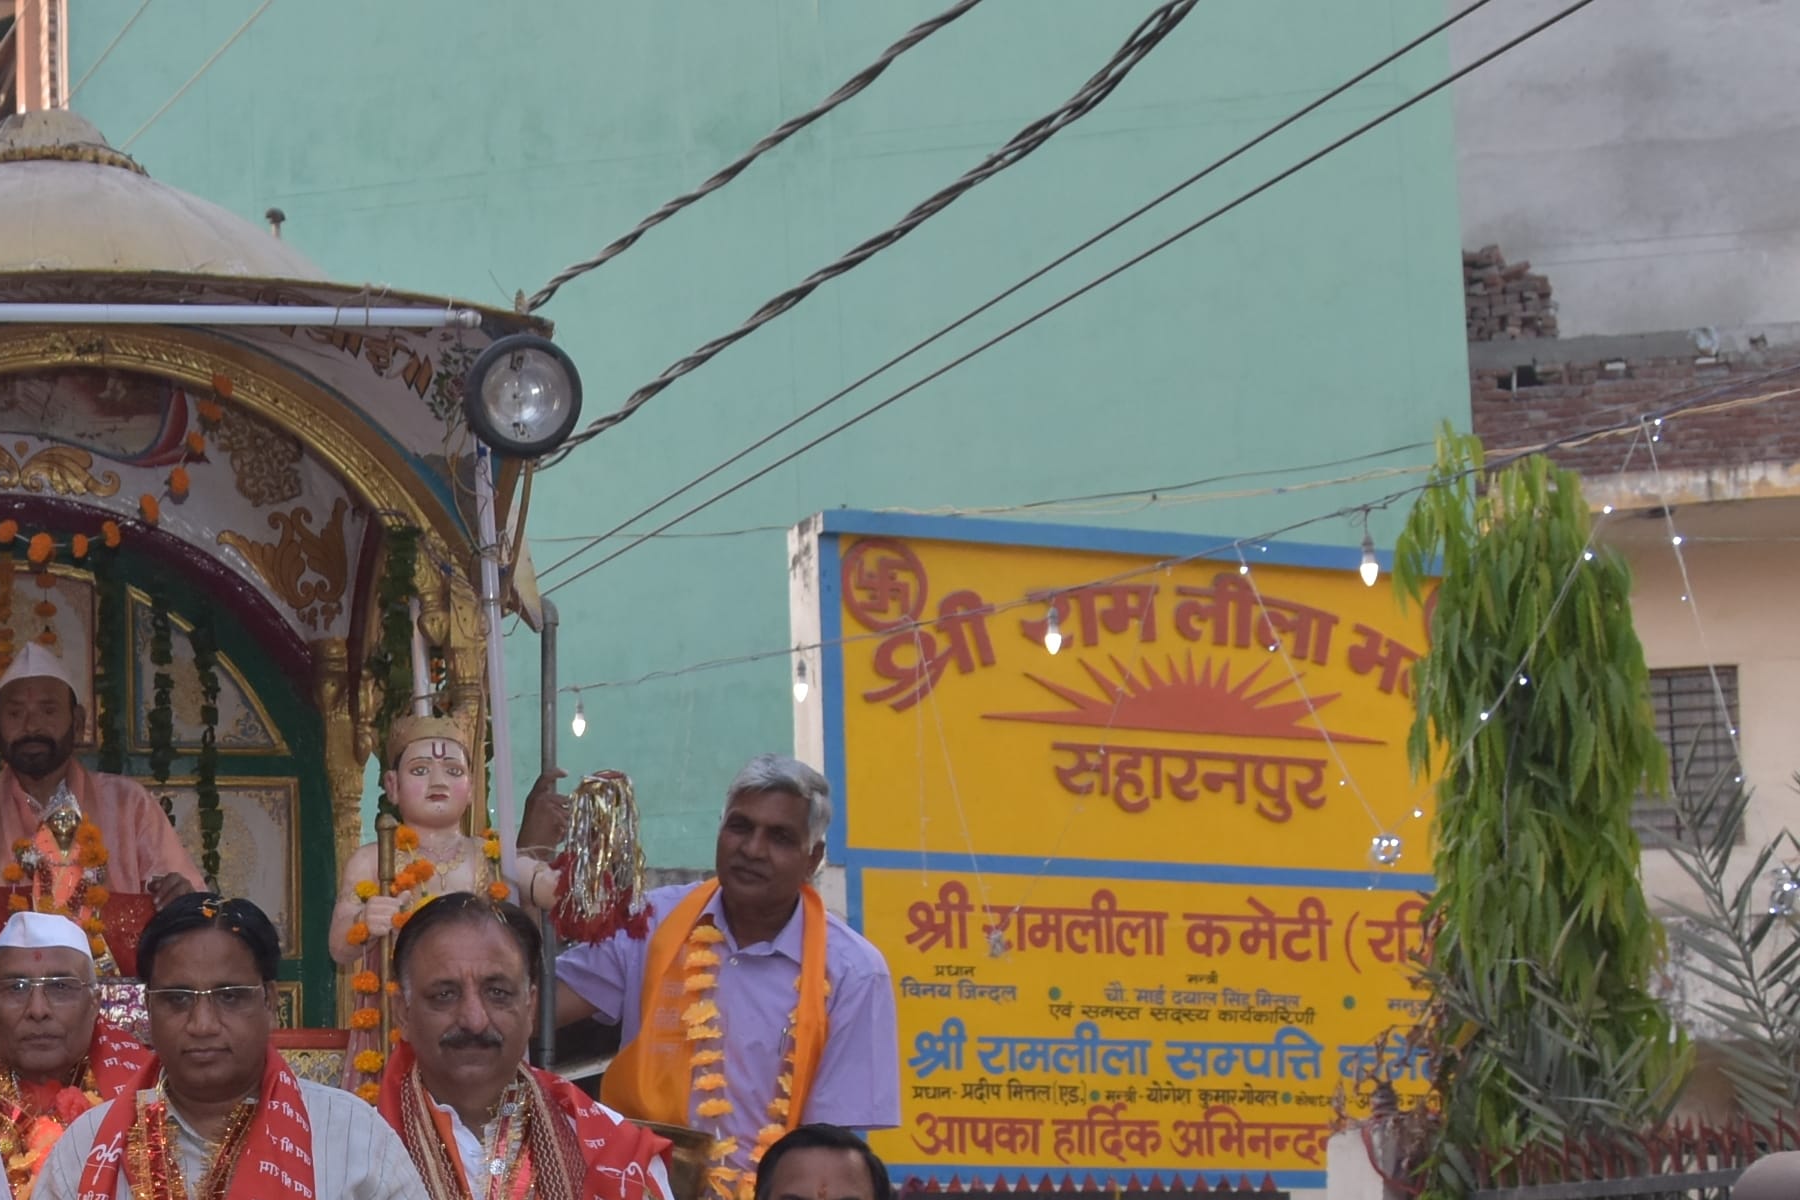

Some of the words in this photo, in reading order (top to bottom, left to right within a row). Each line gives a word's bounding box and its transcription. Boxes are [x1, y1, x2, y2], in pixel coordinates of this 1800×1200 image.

[863, 591, 997, 712] श्री
[1016, 584, 1160, 650] राम
[1175, 572, 1339, 667] लीला
[1052, 741, 1328, 823] सहारनपुर
[905, 880, 974, 953] श्री
[982, 889, 1169, 957] रामलीला
[1182, 896, 1332, 962] कमेटी
[900, 976, 952, 998] विनय
[1048, 1001, 1075, 1020] एवं
[907, 1017, 967, 1079] श्री
[977, 1020, 1152, 1076] रामलीला
[1165, 1026, 1324, 1080] सम्पत्ति
[961, 1077, 1002, 1105] प्रदीप
[910, 1112, 1044, 1155] आपका
[1051, 1101, 1163, 1164] हार्दिक
